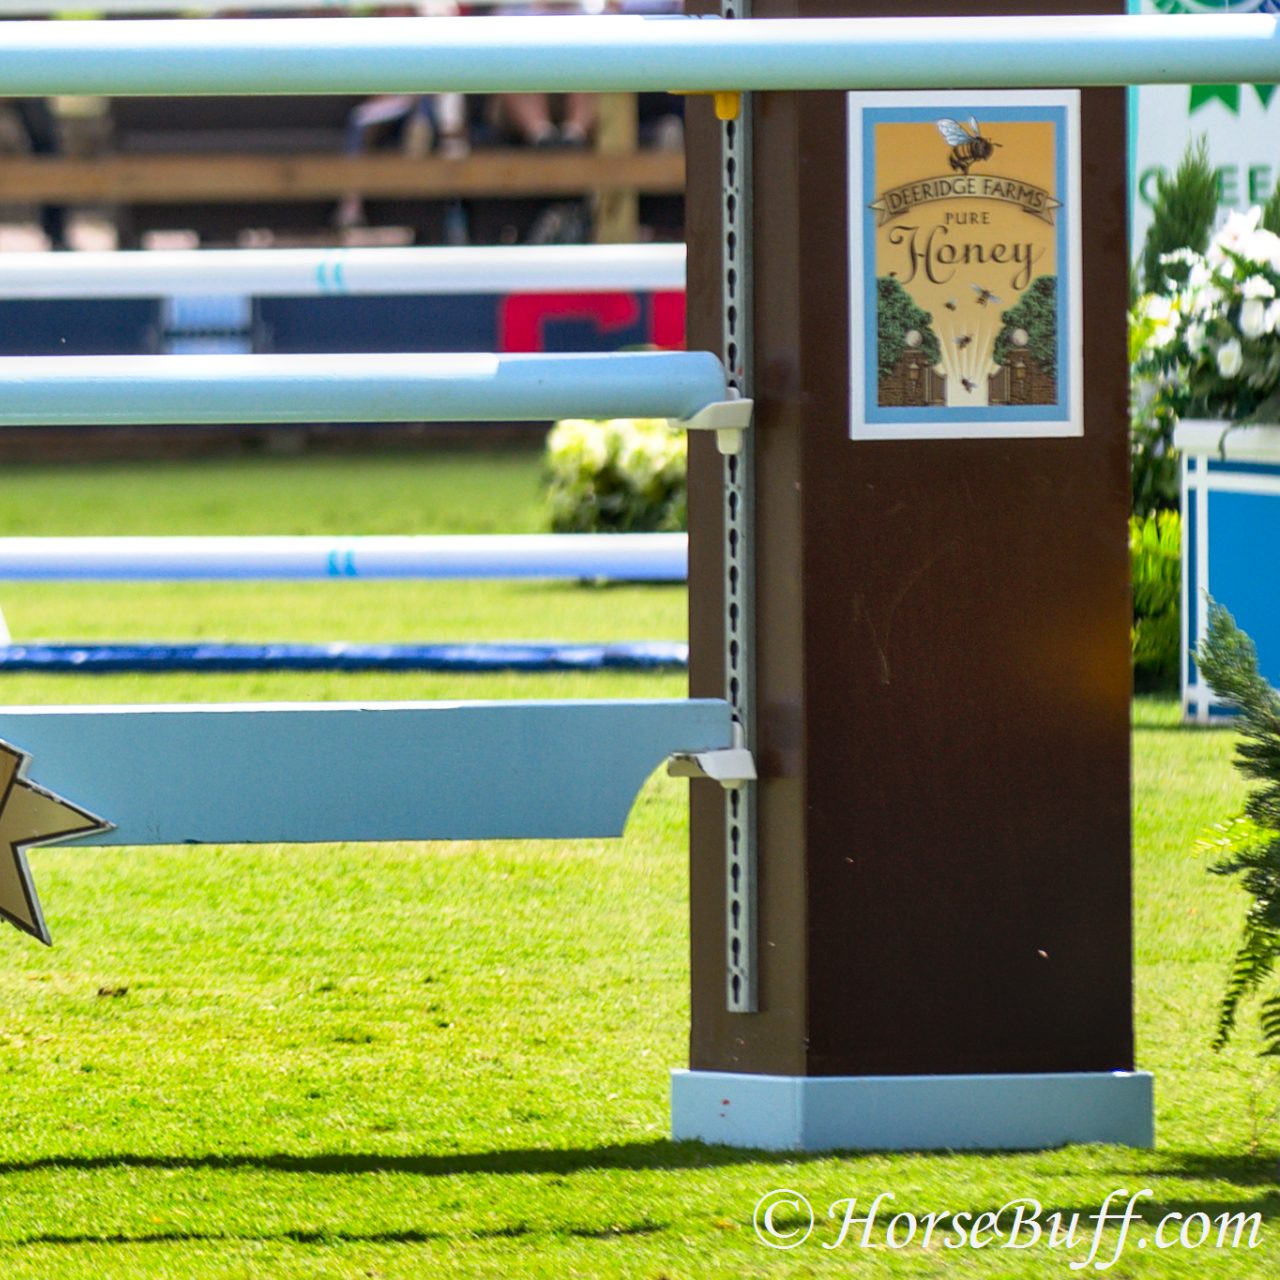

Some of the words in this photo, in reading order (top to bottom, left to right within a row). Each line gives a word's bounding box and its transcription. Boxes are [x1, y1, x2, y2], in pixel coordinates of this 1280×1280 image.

[888, 178, 977, 210] DEERIDGE
[983, 178, 1044, 209] FARMS
[945, 211, 991, 225] PURE
[889, 225, 1046, 291] Honey
